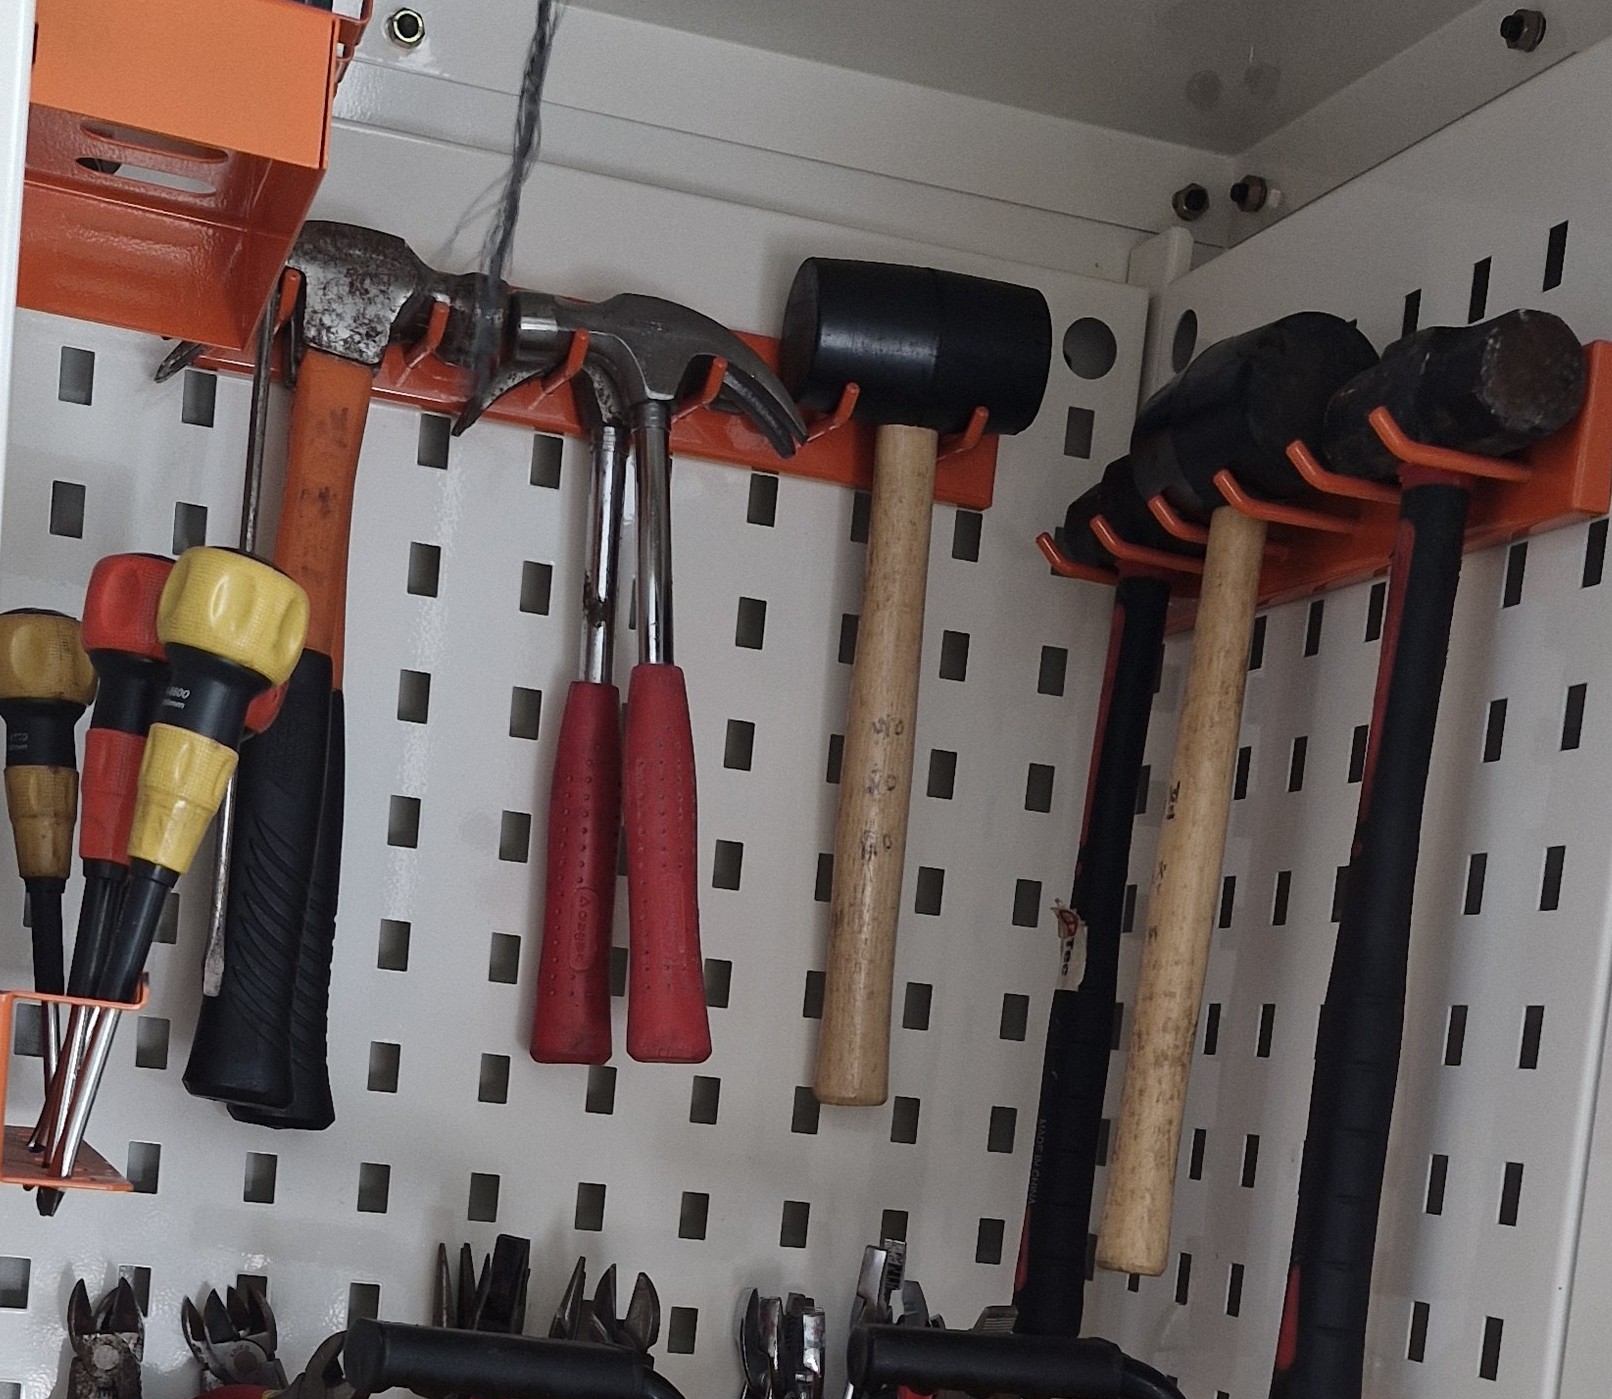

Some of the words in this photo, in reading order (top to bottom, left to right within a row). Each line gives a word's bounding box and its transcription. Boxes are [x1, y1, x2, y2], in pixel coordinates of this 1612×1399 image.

[1034, 1118, 1047, 1153] MADE
[1033, 1154, 1042, 1167] IN
[1028, 1169, 1040, 1205] CHINA
